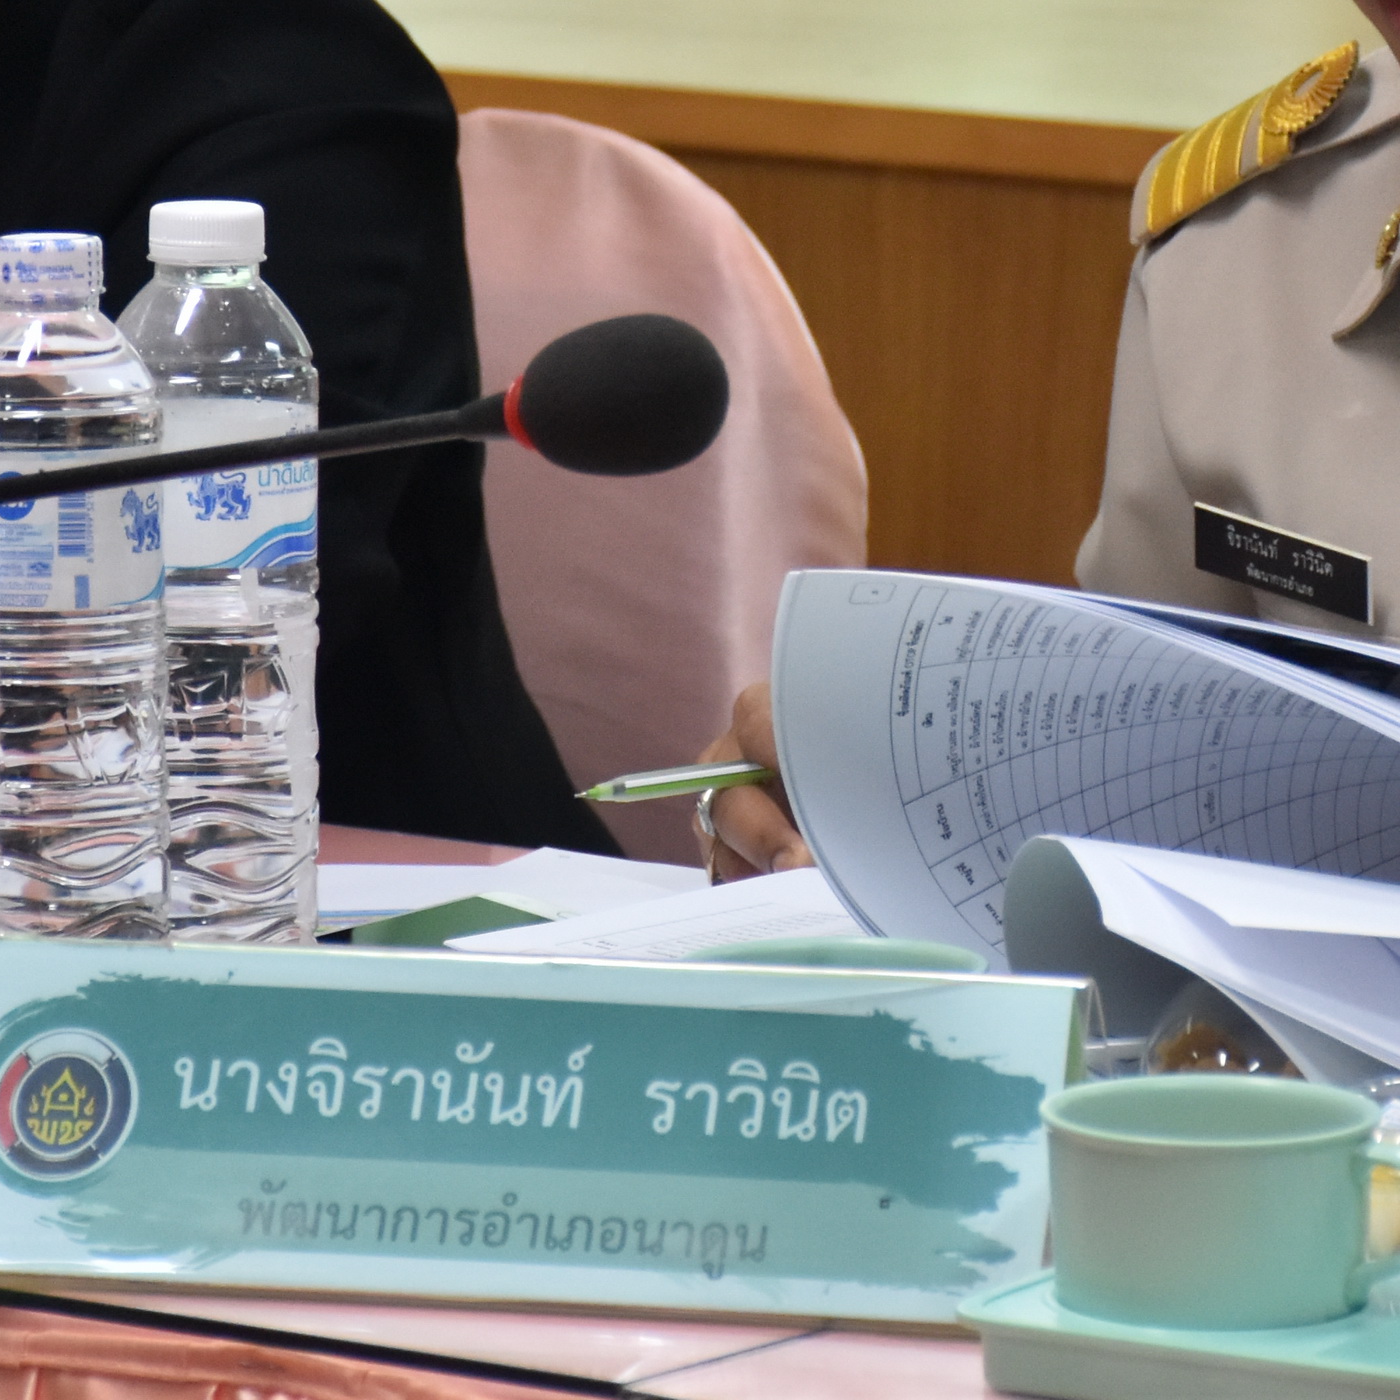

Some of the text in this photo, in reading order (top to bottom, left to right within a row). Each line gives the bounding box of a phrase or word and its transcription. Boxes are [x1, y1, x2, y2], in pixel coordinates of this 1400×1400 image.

[174, 1036, 868, 1144] นางจิรานันท์ ราวินิต
[238, 1179, 768, 1281] พัฒนาการอำเภอนาดูน
